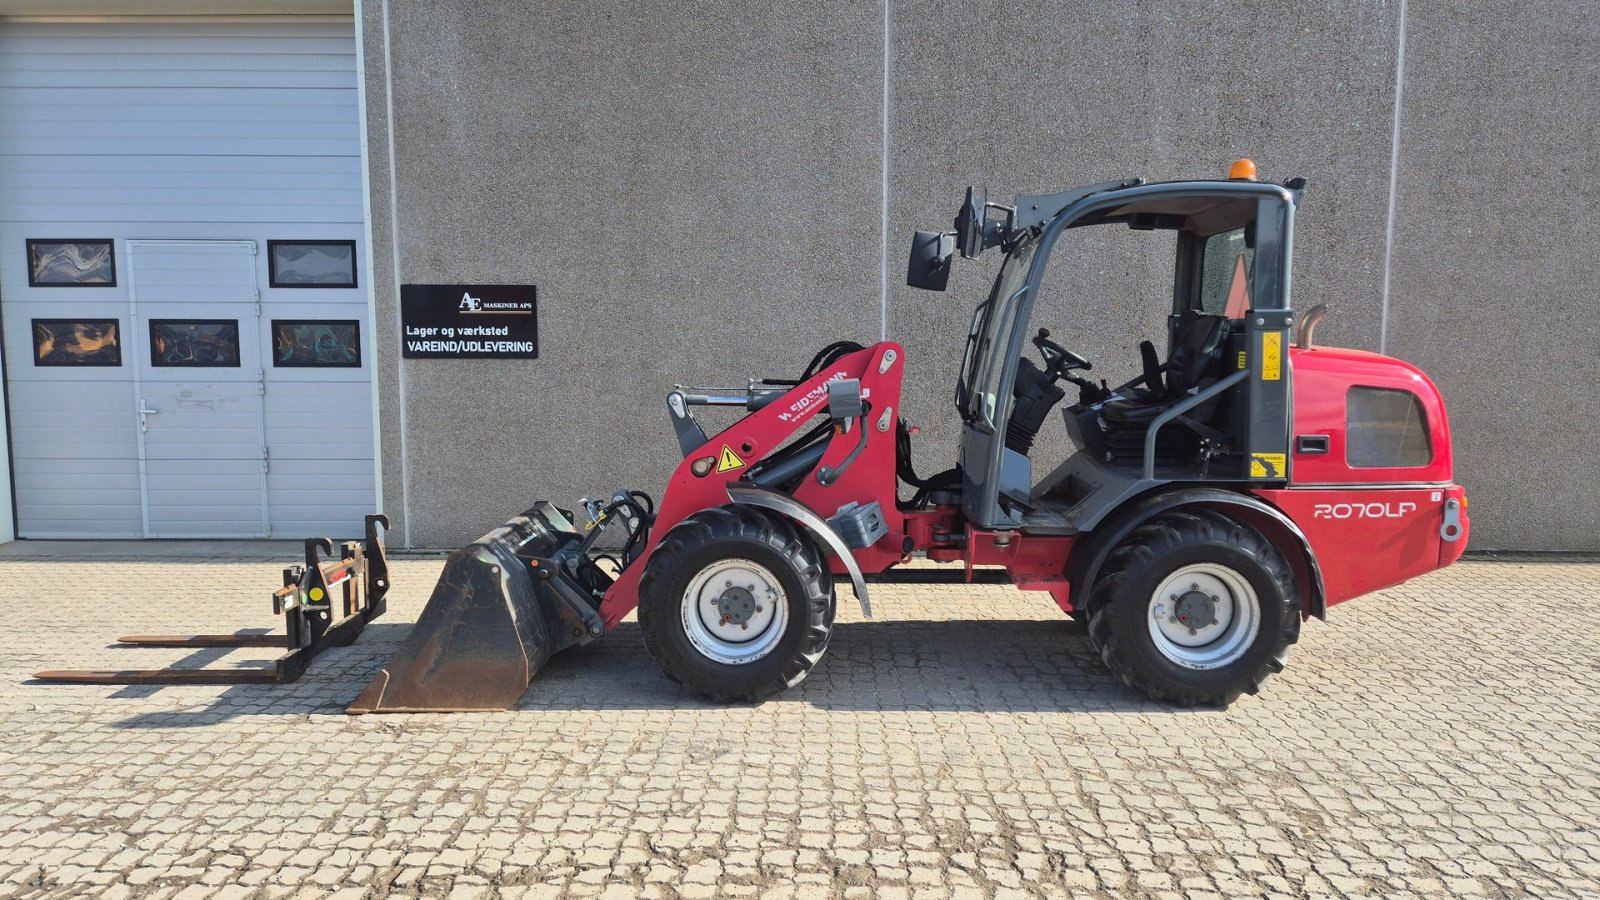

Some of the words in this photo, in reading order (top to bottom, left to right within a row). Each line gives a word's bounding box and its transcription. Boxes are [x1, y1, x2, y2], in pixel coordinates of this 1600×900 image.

[406, 325, 438, 338] Lager
[441, 328, 455, 338] og
[457, 325, 508, 336] værksted
[407, 340, 533, 353] VAREIND/UDLEVERING
